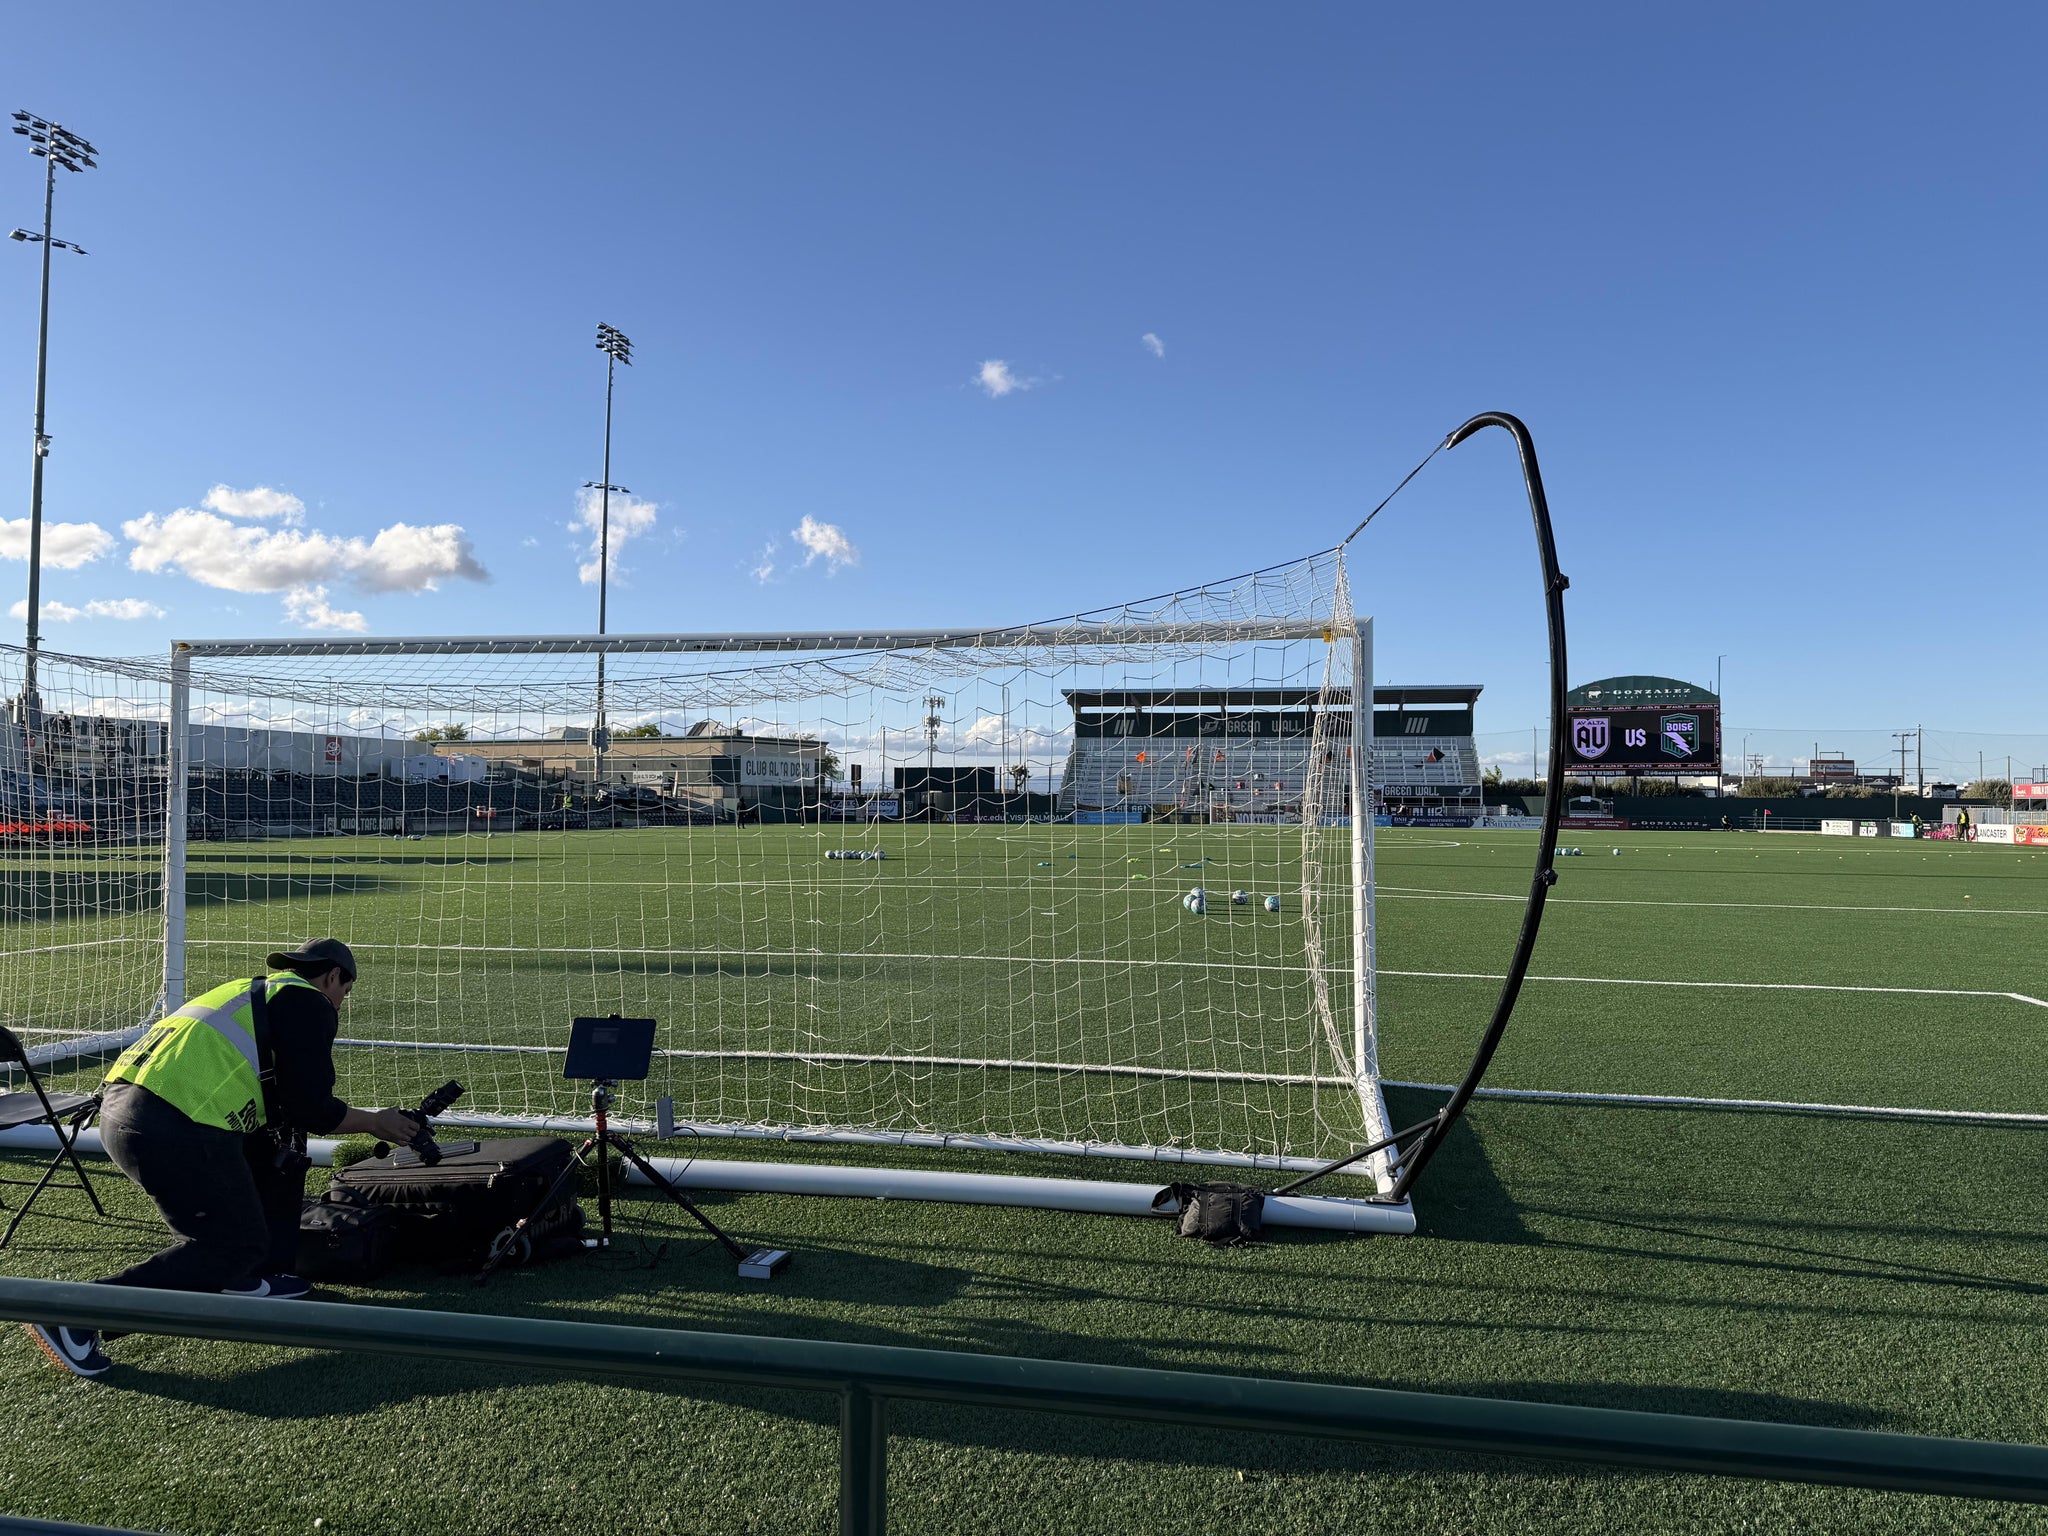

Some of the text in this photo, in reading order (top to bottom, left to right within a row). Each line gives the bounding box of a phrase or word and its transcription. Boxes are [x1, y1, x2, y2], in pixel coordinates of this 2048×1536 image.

[1227, 720, 1301, 732] GREEN WALL
[1666, 722, 1694, 731] BOISE
[746, 760, 810, 777] CLUB ALTA DECK
[1385, 786, 1439, 796] GREEN WALL
[1977, 828, 2007, 838] LANCASTER
